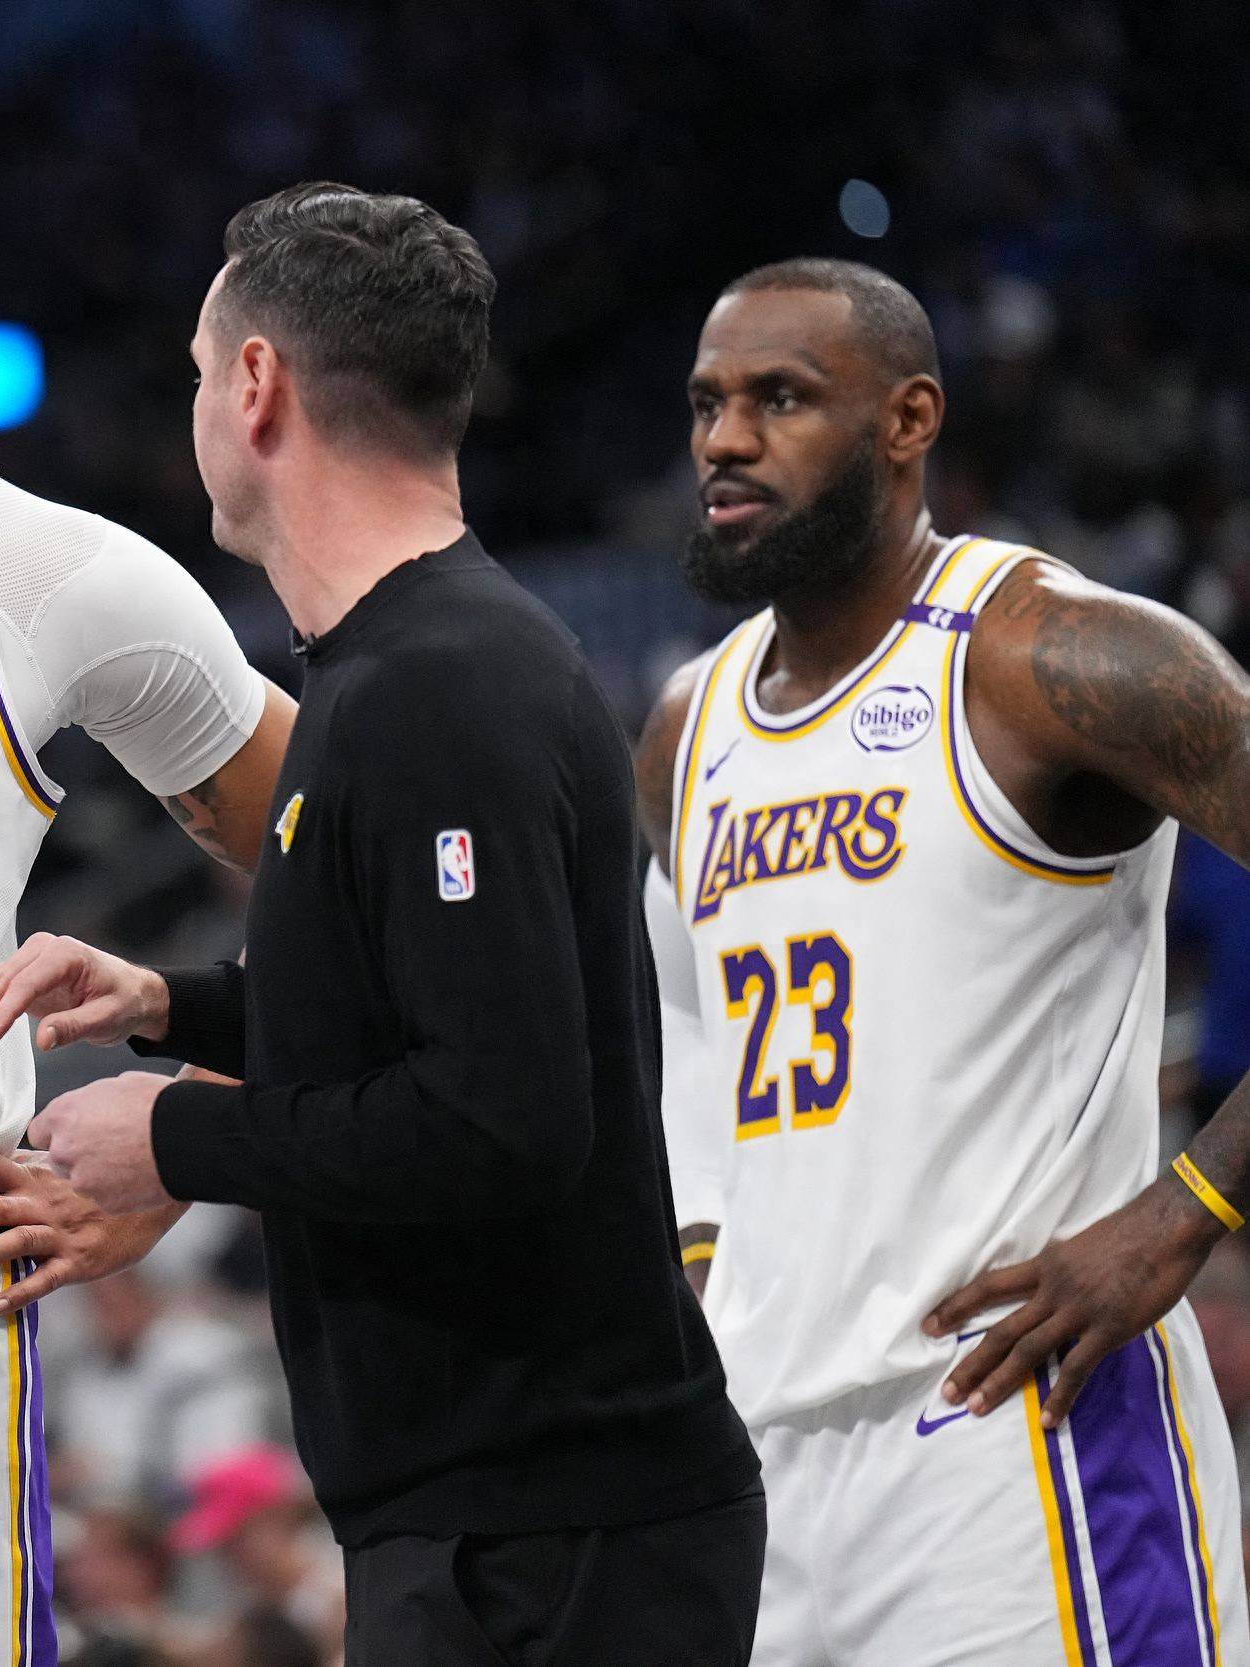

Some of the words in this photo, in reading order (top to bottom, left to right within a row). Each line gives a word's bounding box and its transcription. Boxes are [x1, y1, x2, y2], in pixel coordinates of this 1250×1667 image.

[859, 703, 929, 732] bibigo
[692, 785, 910, 927] LAKERS
[719, 929, 855, 1143] 23
